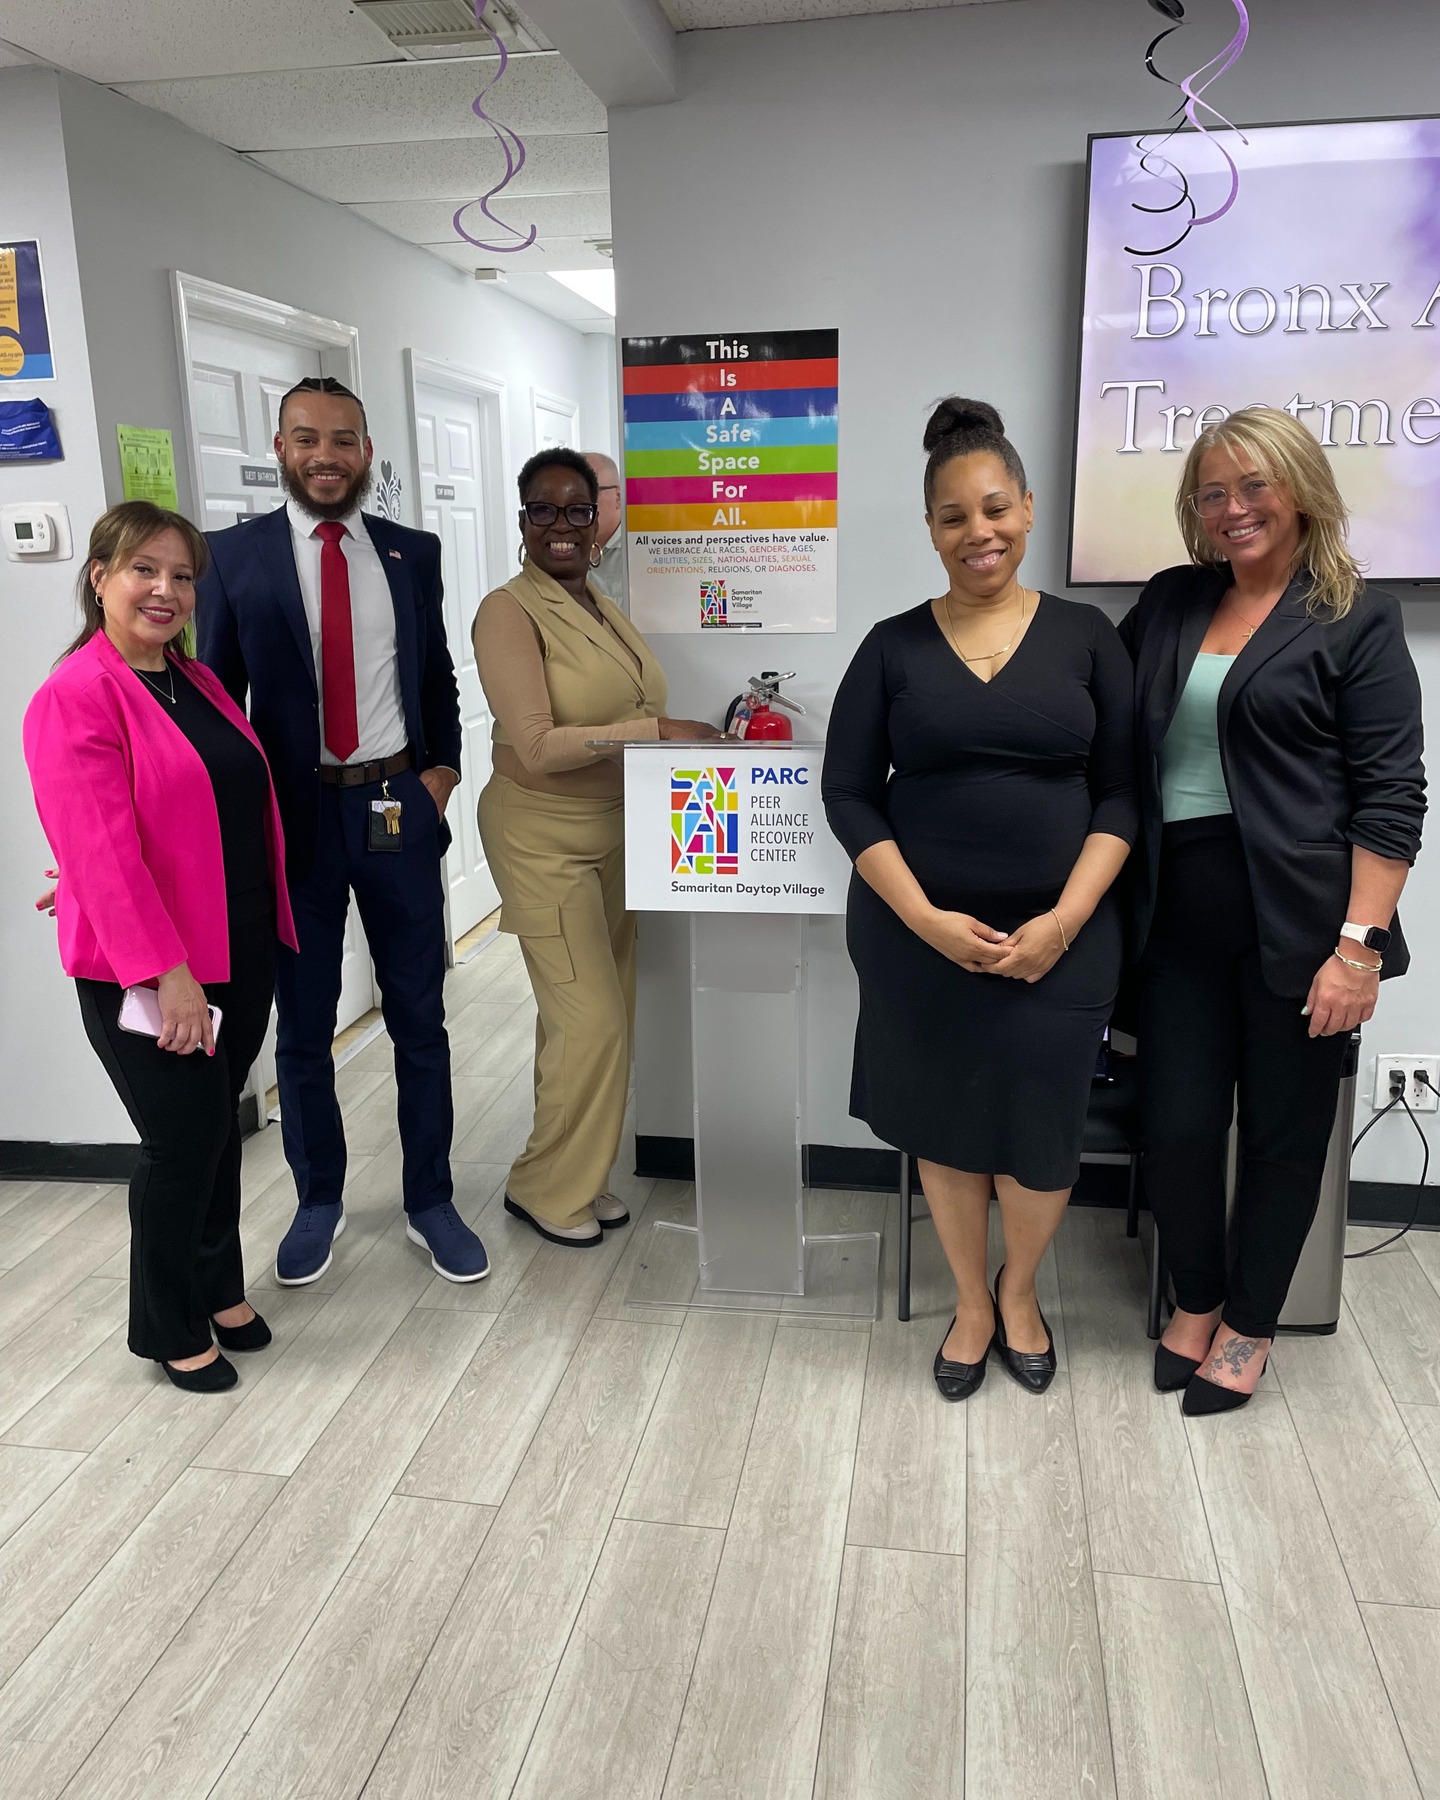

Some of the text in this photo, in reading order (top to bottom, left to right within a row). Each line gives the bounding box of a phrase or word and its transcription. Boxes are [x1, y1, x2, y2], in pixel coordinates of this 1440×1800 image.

[1131, 263, 1391, 340] Bronx
[706, 340, 750, 360] This
[720, 368, 736, 387] Is
[720, 397, 736, 416] A
[706, 424, 752, 444] Safe
[698, 452, 760, 474] Space
[245, 471, 276, 482] GUEST BATHROOM
[712, 481, 748, 499] For
[712, 508, 746, 526] All.
[636, 532, 829, 546] All voices and perspectives have value.
[719, 546, 747, 554] RACES,
[750, 545, 790, 554] GENDERS,
[792, 545, 816, 553] AGES,
[653, 556, 690, 565] ABILITIES,
[718, 555, 779, 564] NATIONALITIES,
[647, 566, 706, 574] ORIENTATIONS,
[751, 768, 809, 785] PARC
[750, 796, 781, 809] PEER
[750, 814, 809, 826] ALLIANCE
[750, 831, 814, 844] RECOVERY
[750, 849, 796, 862] CENTER
[671, 881, 825, 897] Samaritan Daytop Village
